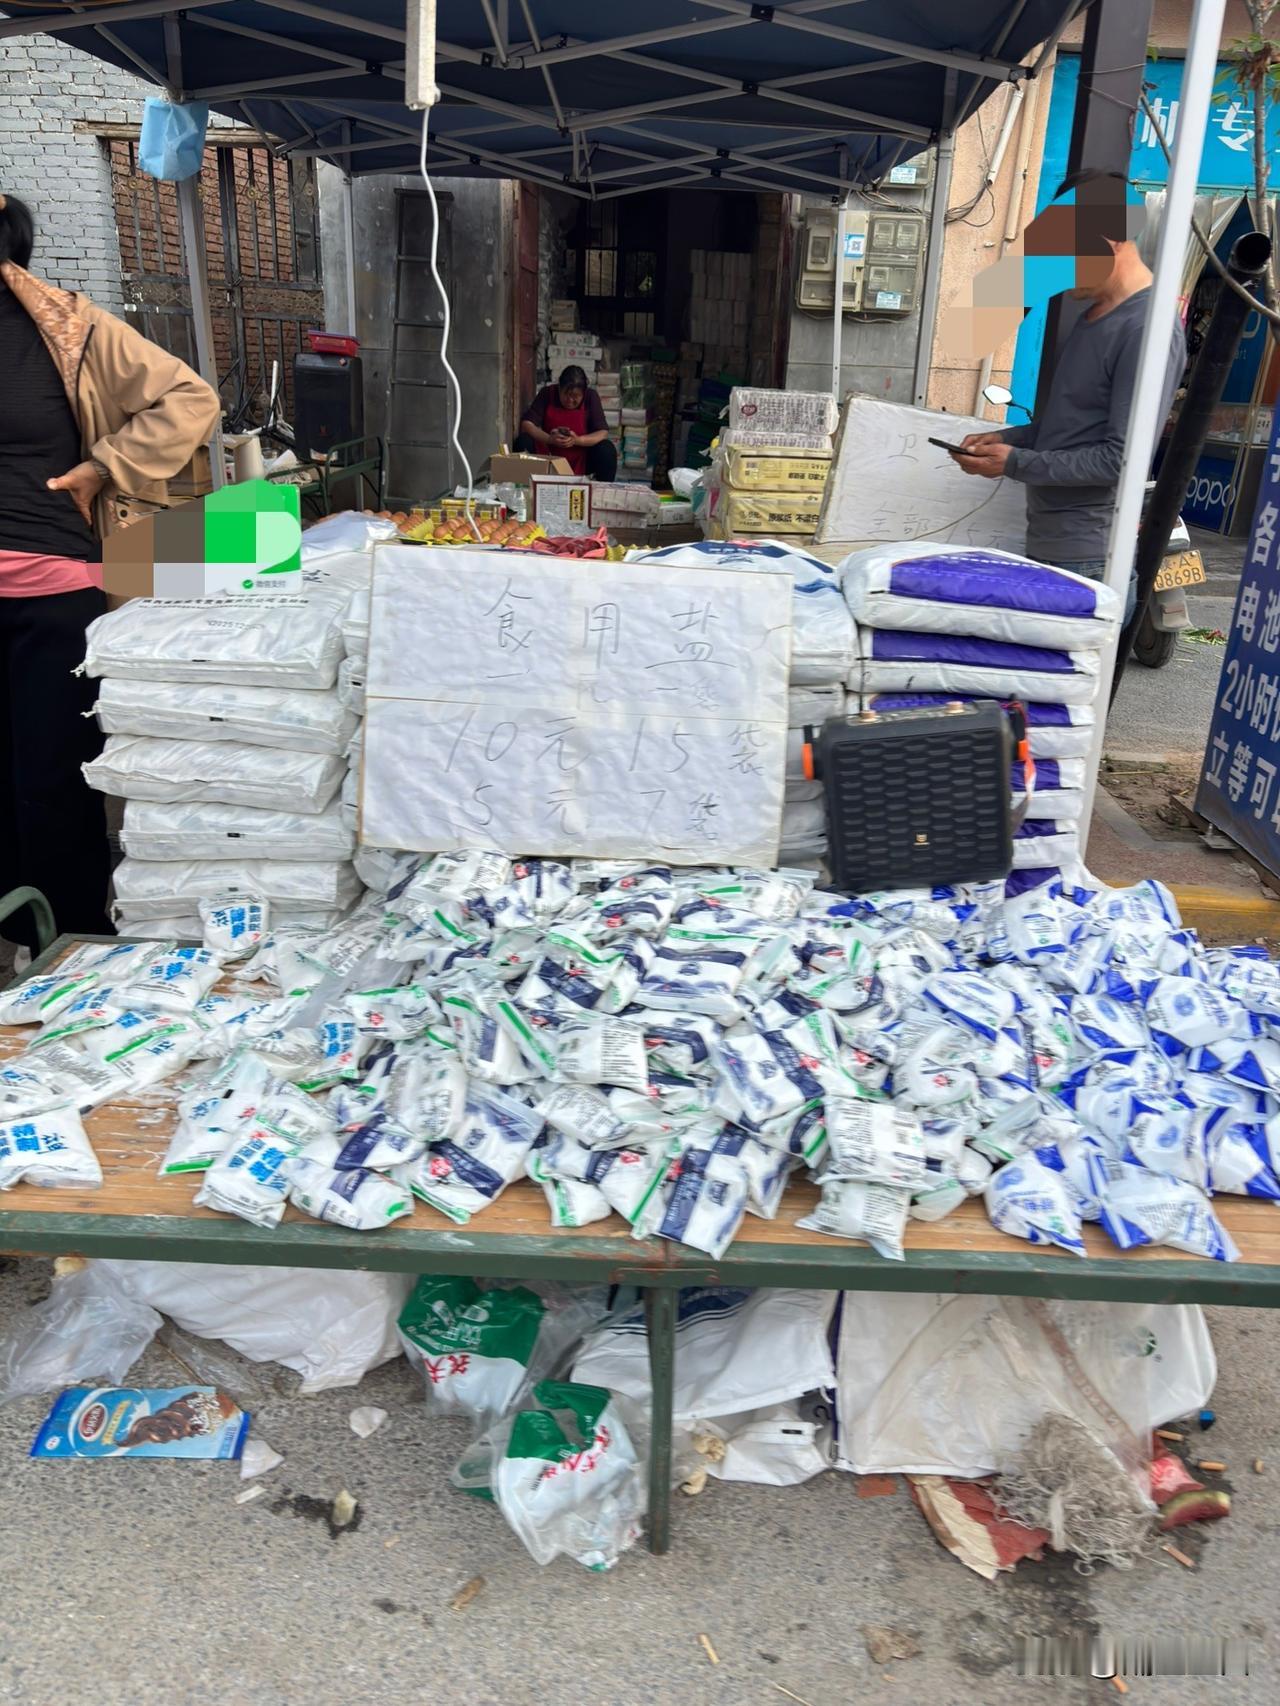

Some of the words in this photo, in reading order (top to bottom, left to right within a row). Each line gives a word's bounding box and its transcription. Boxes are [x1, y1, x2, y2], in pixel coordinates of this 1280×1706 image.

[1186, 475, 1236, 511] oppo
[1251, 501, 1280, 570] 各
[483, 577, 736, 669] 食用盐
[1220, 659, 1280, 742] 2小时
